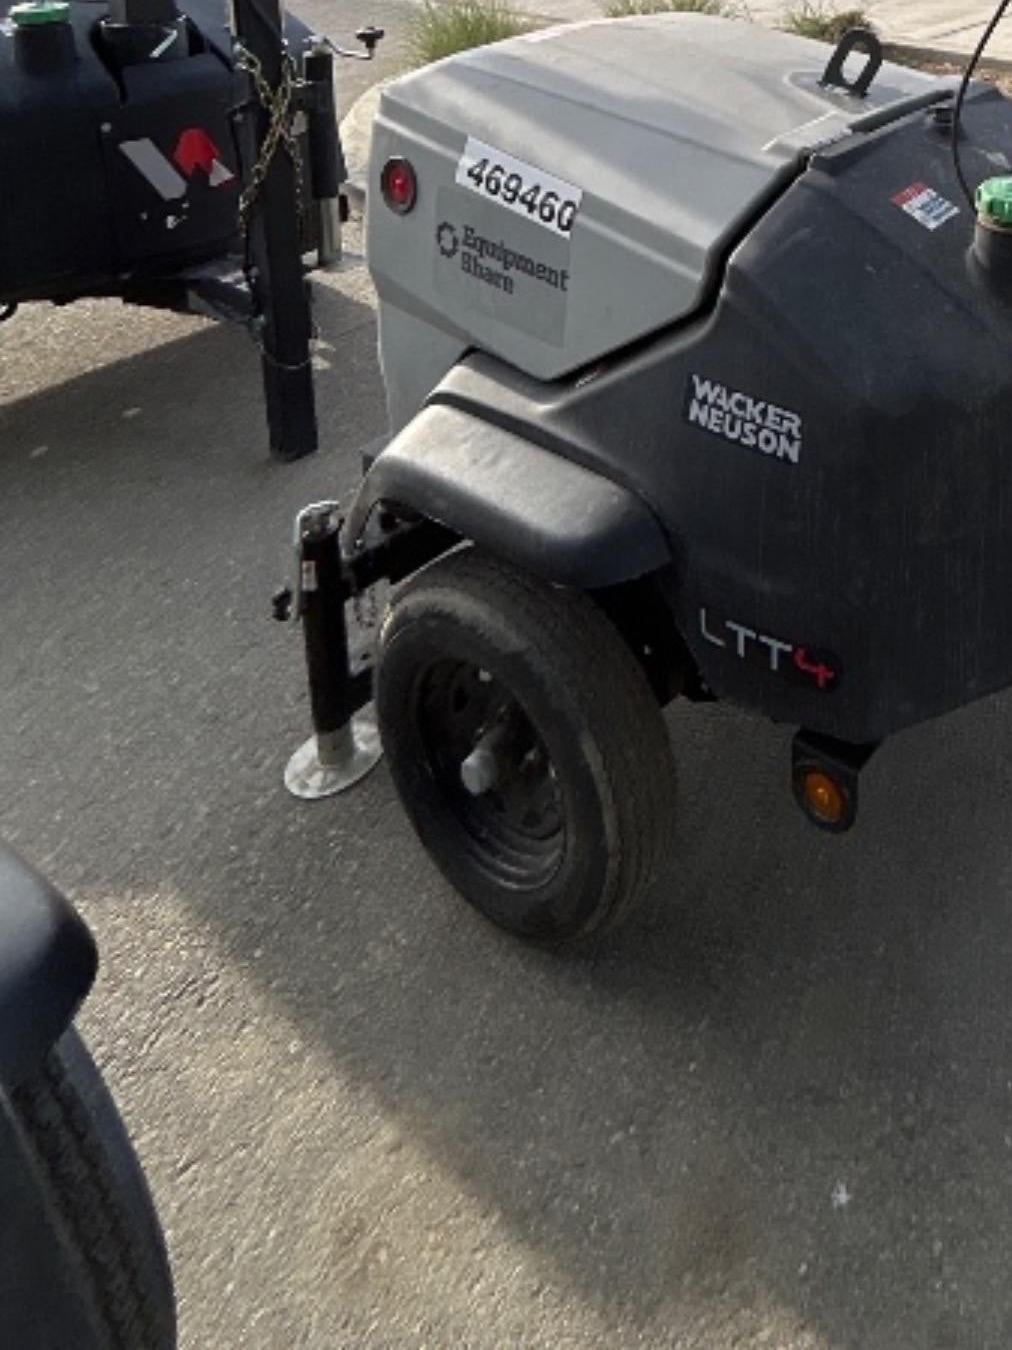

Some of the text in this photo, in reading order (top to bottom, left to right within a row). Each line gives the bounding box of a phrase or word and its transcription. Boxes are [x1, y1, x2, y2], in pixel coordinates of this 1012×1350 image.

[467, 158, 577, 232] 469460
[462, 225, 570, 292] Equipment
[689, 399, 802, 464] NEUSON
[692, 374, 802, 439] WACKER
[700, 607, 835, 688] LTT4
